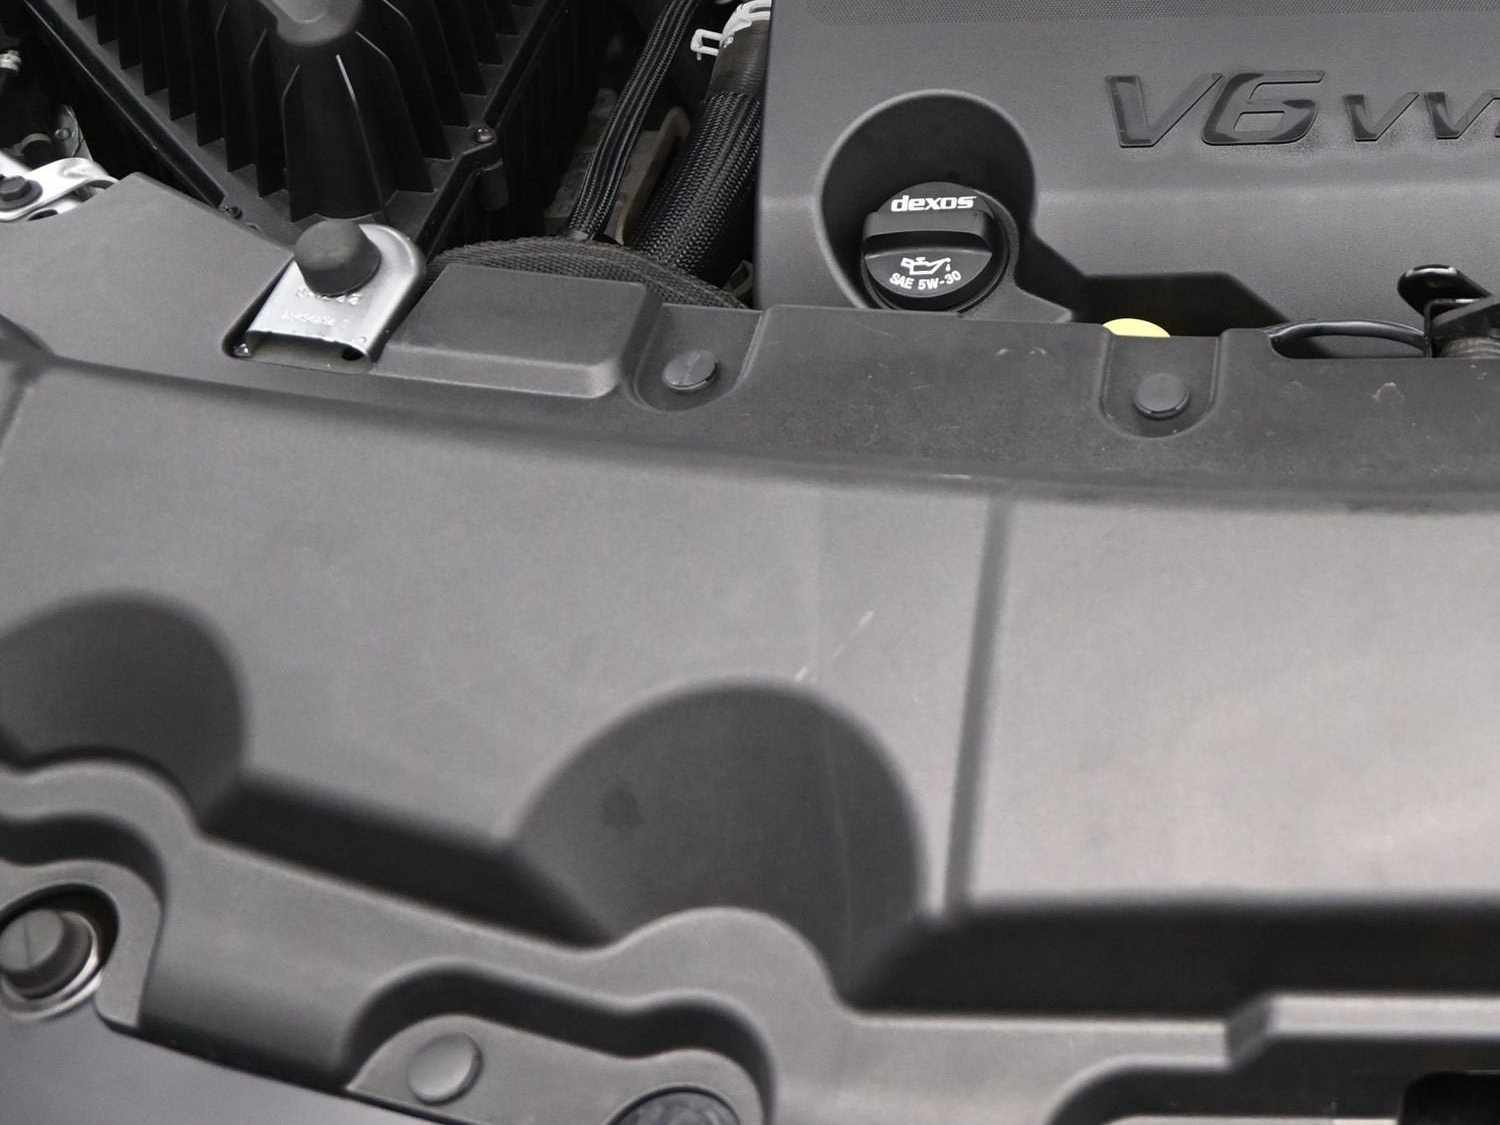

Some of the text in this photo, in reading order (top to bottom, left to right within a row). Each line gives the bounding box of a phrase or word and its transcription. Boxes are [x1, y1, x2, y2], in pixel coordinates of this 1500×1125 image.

[1105, 70, 1326, 148] V6
[891, 195, 977, 212] dexos
[889, 270, 962, 290] SAE 5W-30
